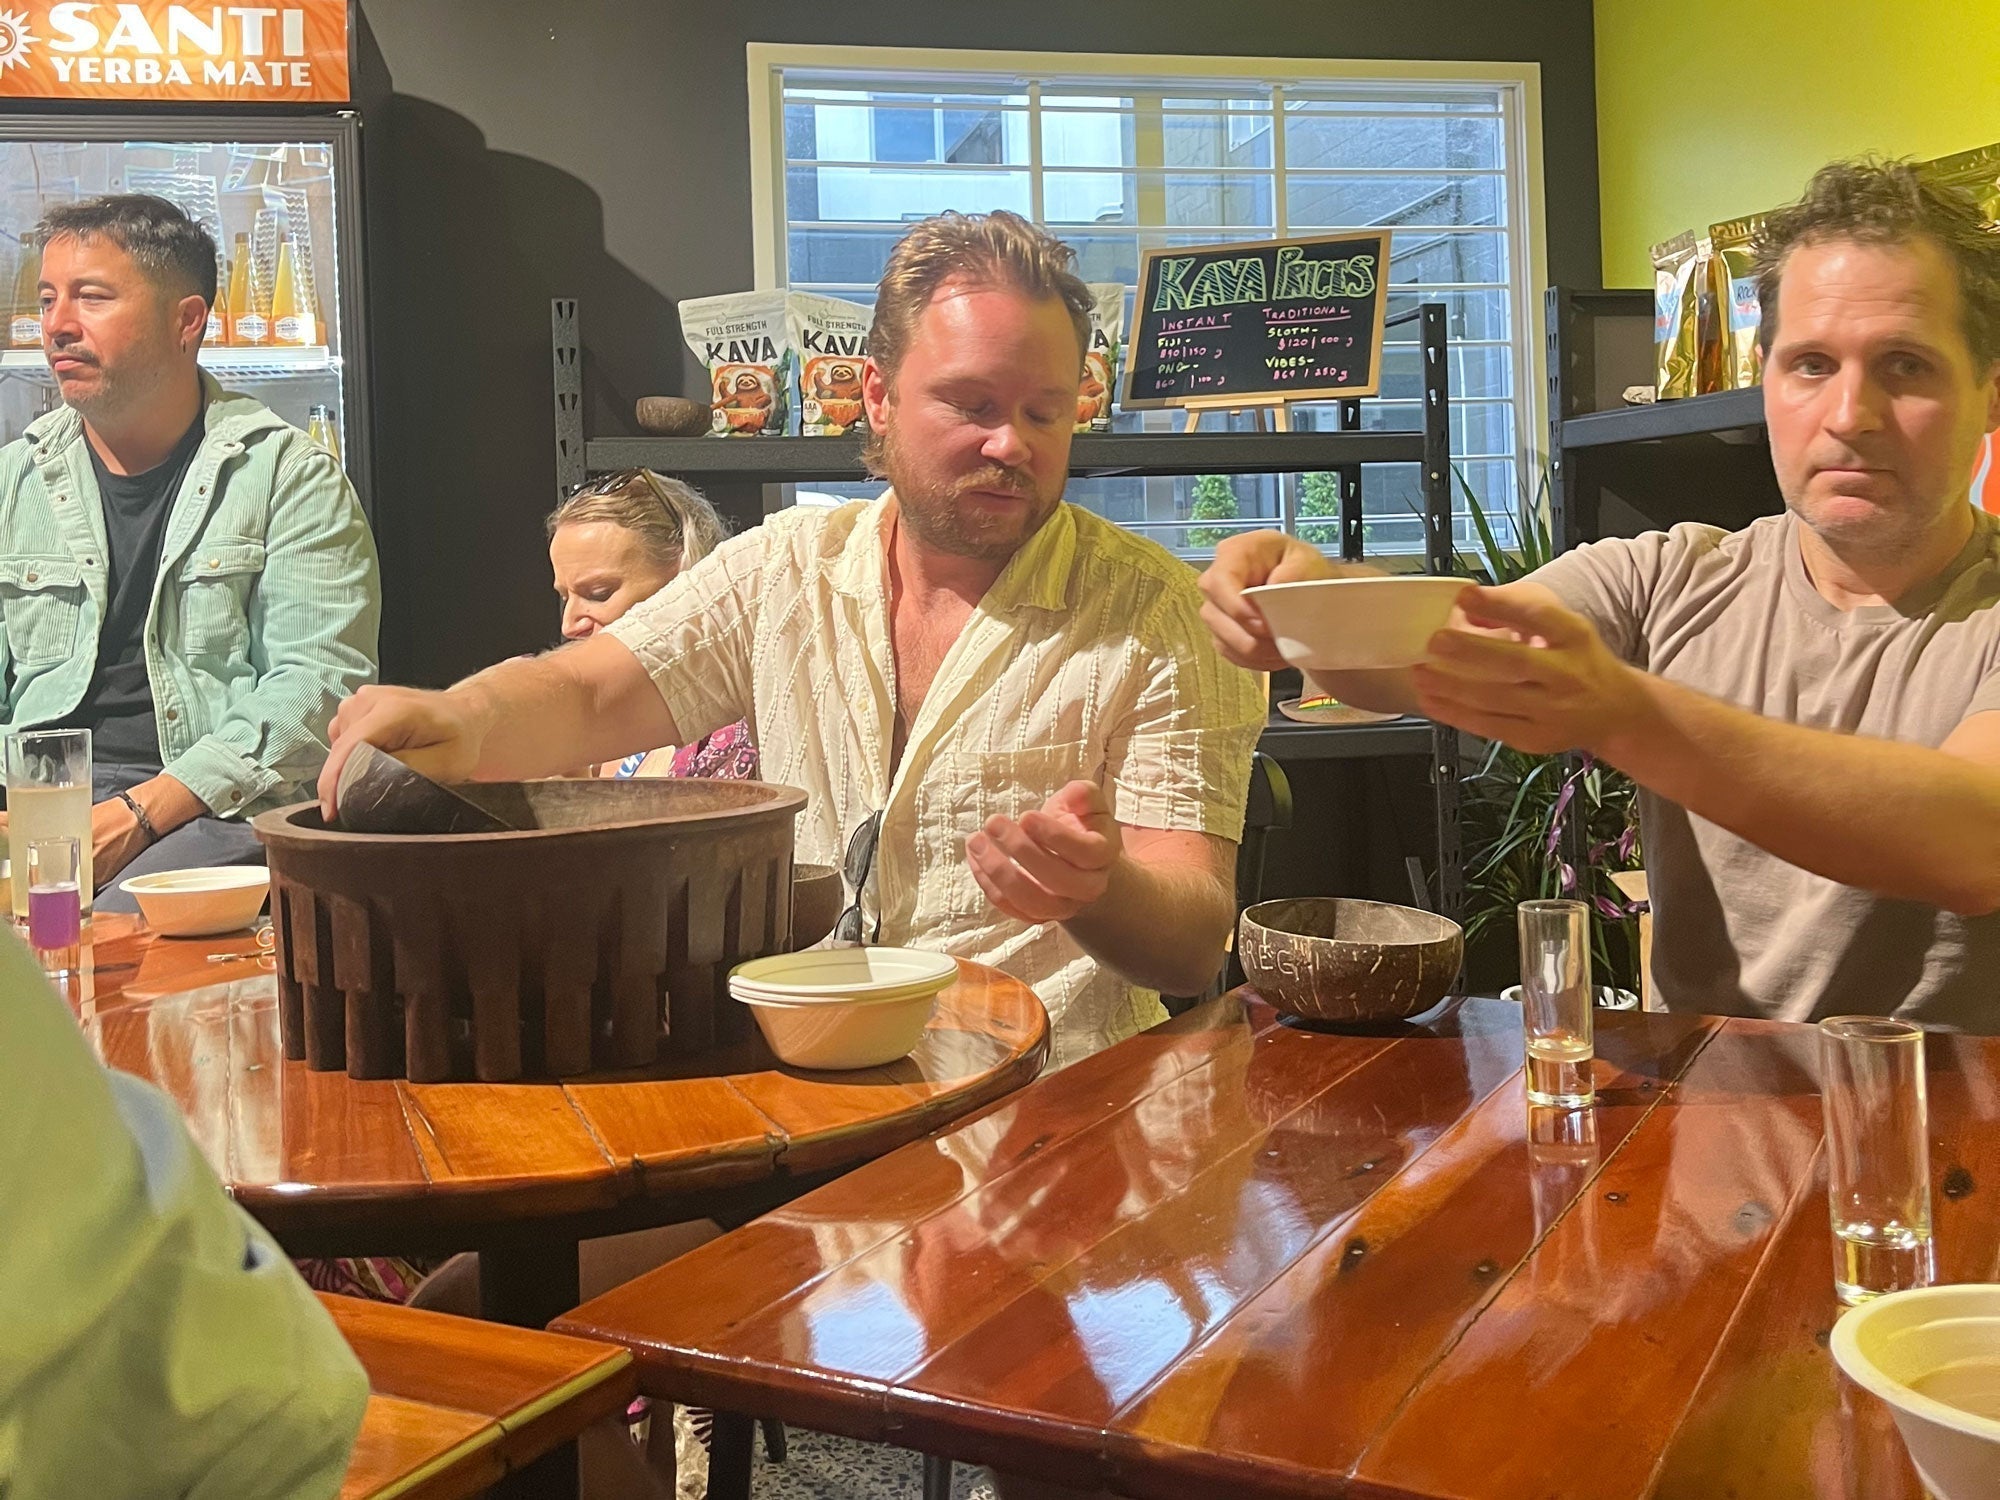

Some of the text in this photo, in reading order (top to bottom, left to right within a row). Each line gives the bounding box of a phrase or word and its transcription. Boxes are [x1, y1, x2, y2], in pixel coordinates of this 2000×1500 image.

[49, 2, 304, 57] SANTI
[50, 57, 312, 87] YERBA MATE
[1152, 246, 1376, 312] KAVA PRICES
[1162, 313, 1232, 330] INSTANT
[1262, 306, 1350, 319] TRADITIONAL
[706, 320, 768, 336] FULL STRENGTH
[825, 320, 867, 332] STRENGTH
[706, 336, 778, 363] KAVA
